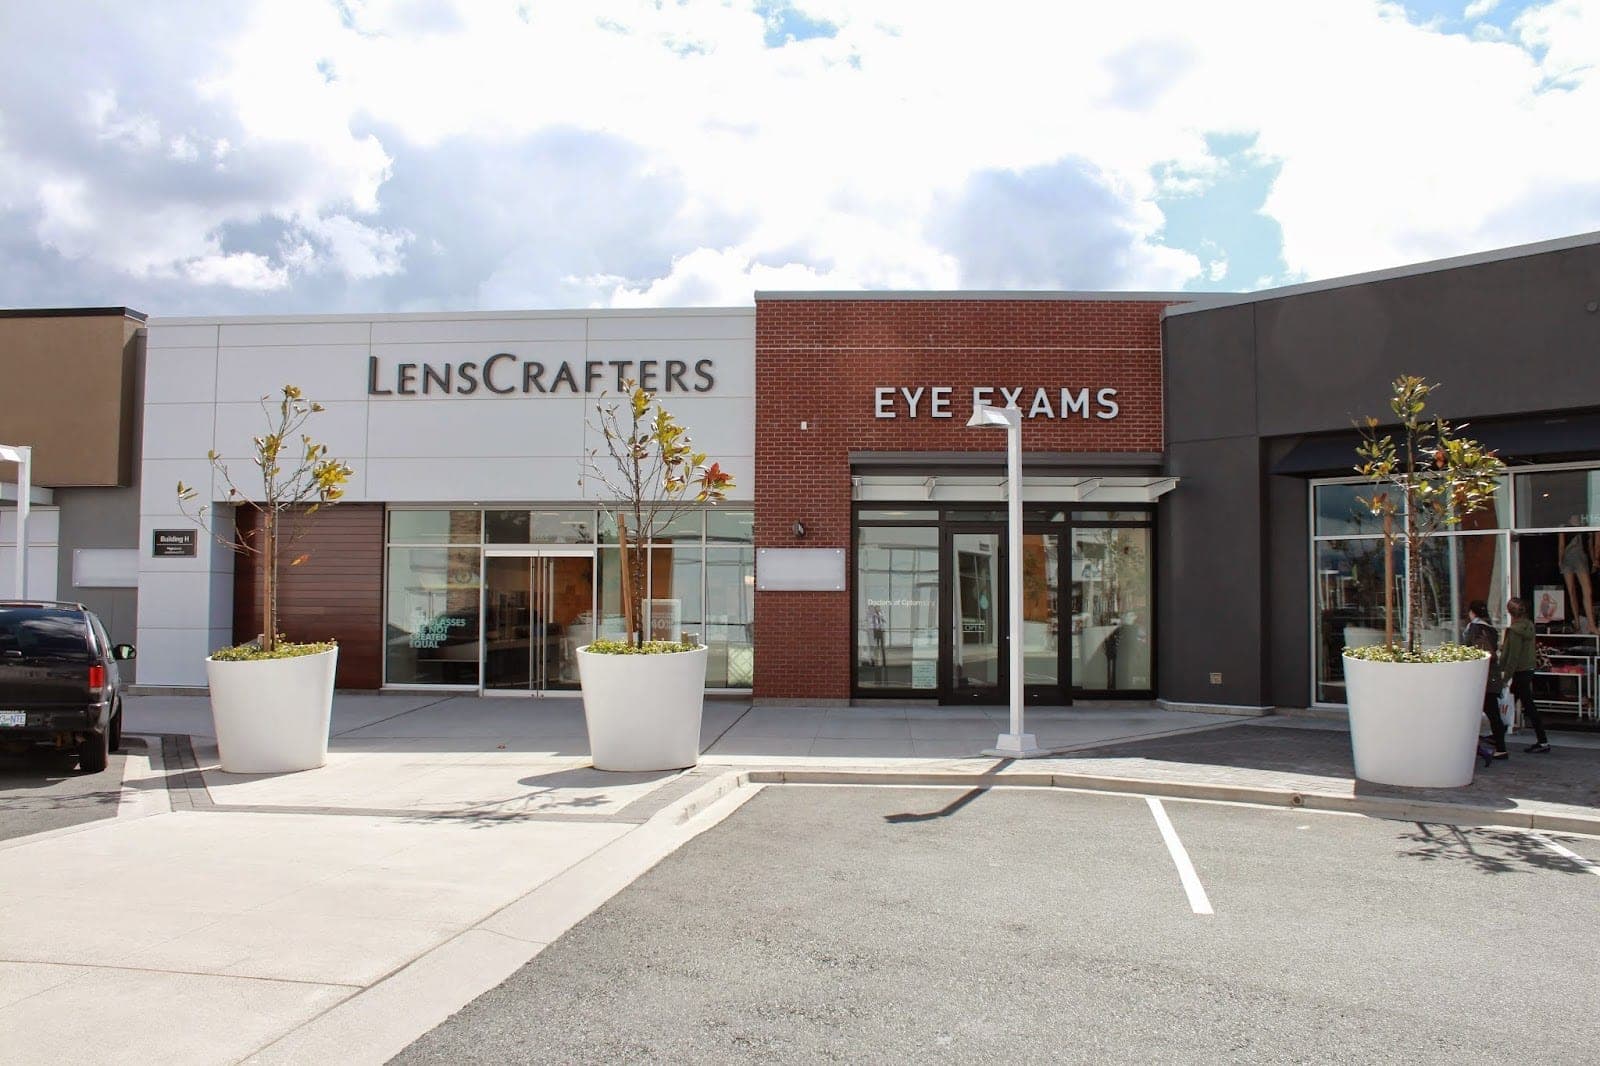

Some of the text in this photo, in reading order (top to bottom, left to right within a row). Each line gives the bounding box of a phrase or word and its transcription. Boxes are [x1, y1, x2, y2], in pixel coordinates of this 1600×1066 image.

[875, 386, 1120, 419] EYE EXAMS
[160, 535, 184, 543] Building
[901, 599, 936, 608] Optom
[411, 618, 466, 627] GLASSES
[429, 626, 448, 634] NOT
[409, 633, 447, 641] CREATED
[409, 640, 440, 648] EQUAL
